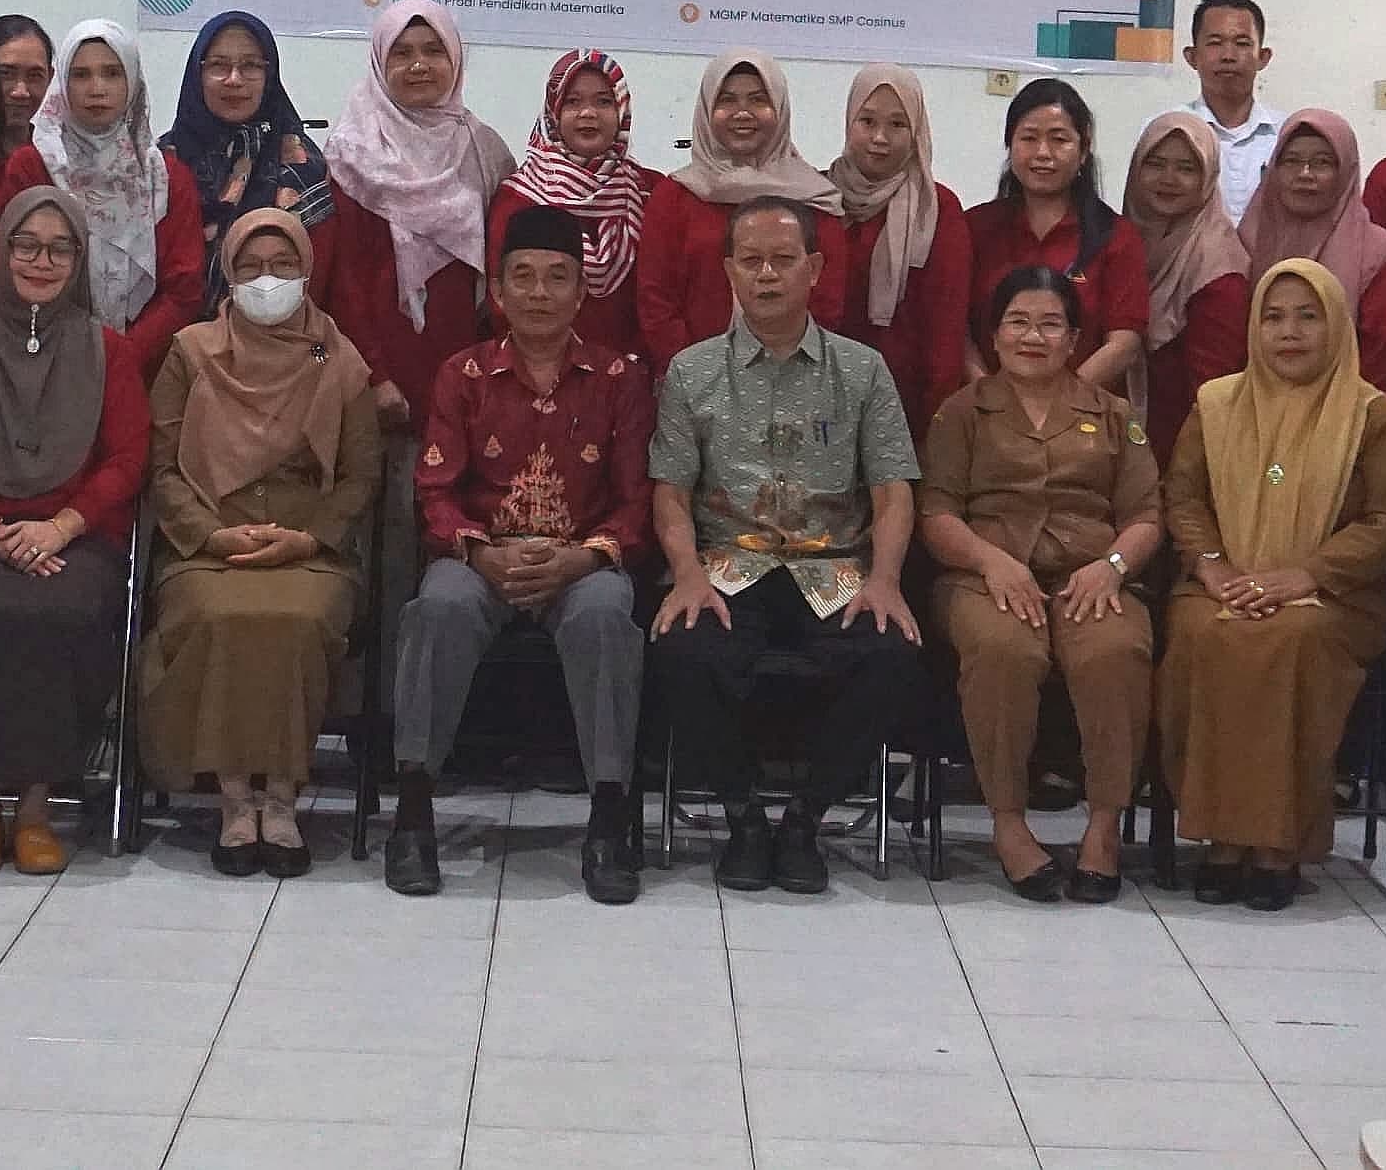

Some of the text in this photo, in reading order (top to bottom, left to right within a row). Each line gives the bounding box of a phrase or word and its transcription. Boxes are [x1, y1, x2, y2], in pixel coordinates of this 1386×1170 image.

[551, 1, 625, 15] Matematika
[709, 9, 748, 21] MGMP
[751, 11, 825, 25] Matematika
[828, 14, 854, 26] SMP
